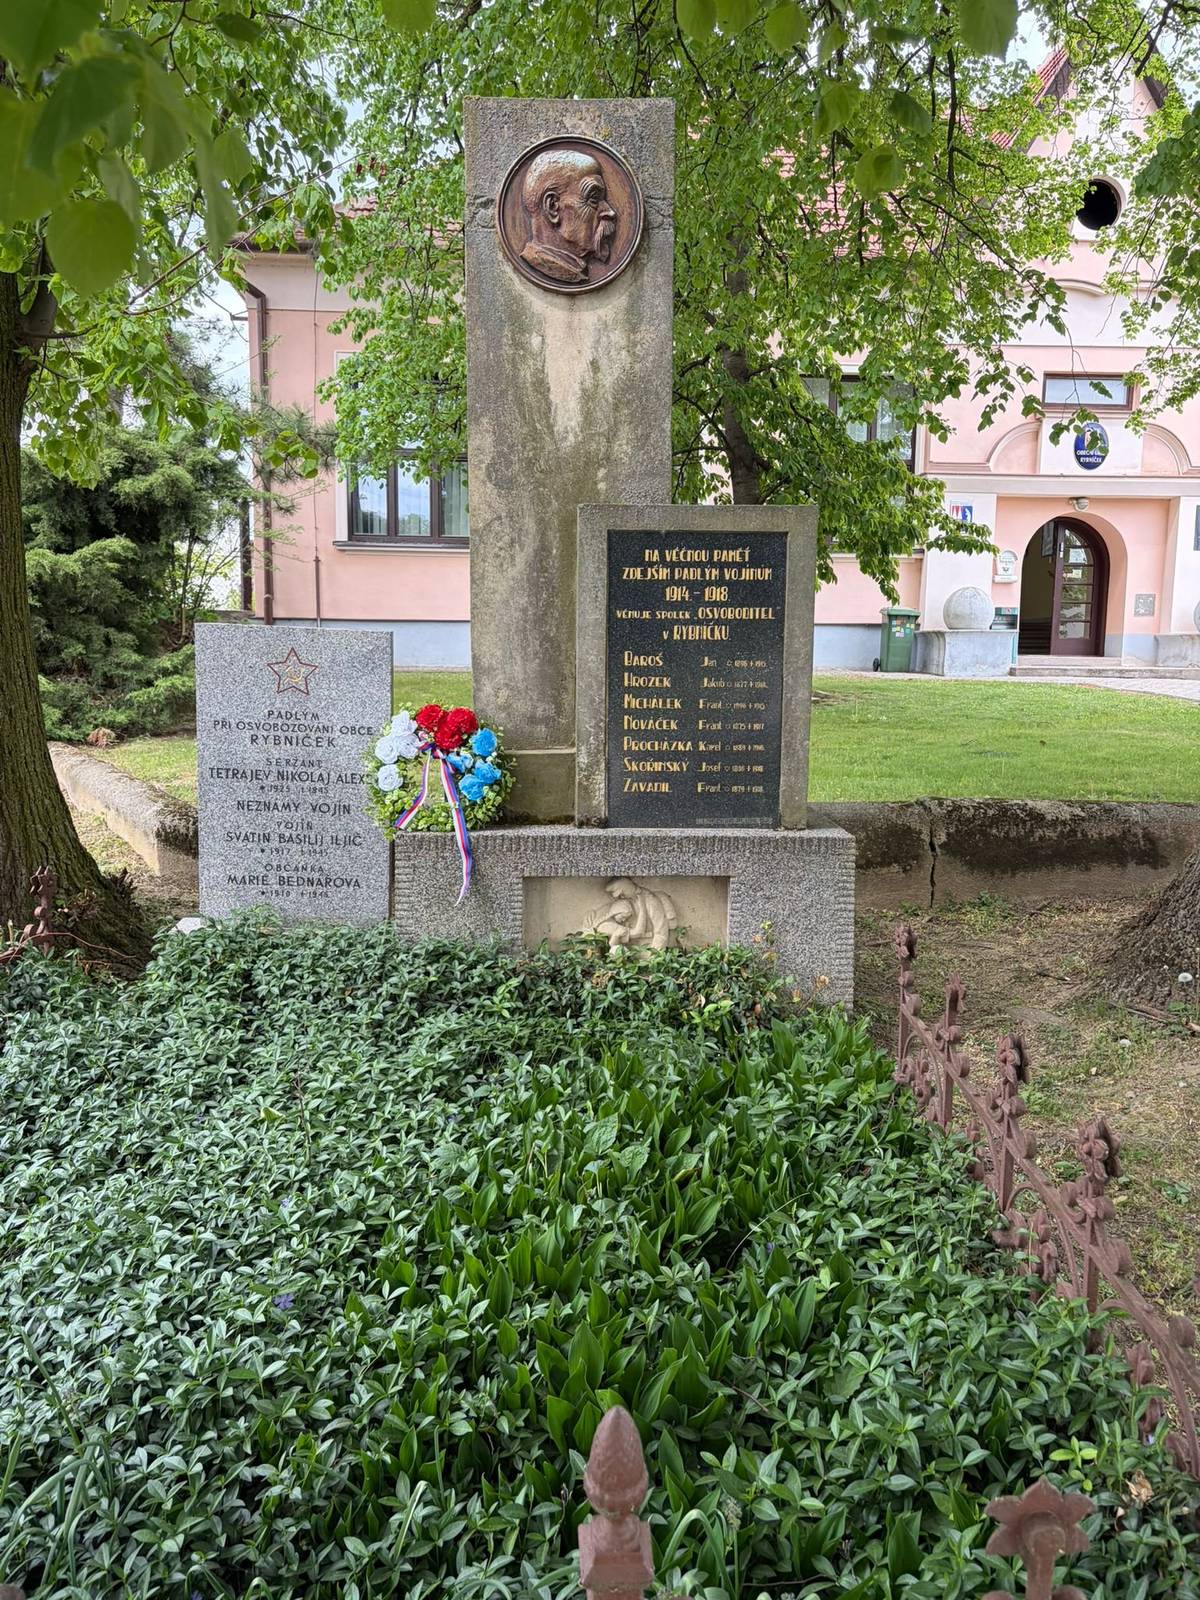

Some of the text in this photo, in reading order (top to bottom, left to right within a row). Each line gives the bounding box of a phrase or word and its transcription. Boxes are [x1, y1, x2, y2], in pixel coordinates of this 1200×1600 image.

[644, 549, 660, 562] NA
[655, 610, 691, 620] SPOLEK
[339, 726, 374, 736] OBCE
[209, 767, 272, 783] TETRAJEV
[277, 769, 330, 786] NIKOLAJ
